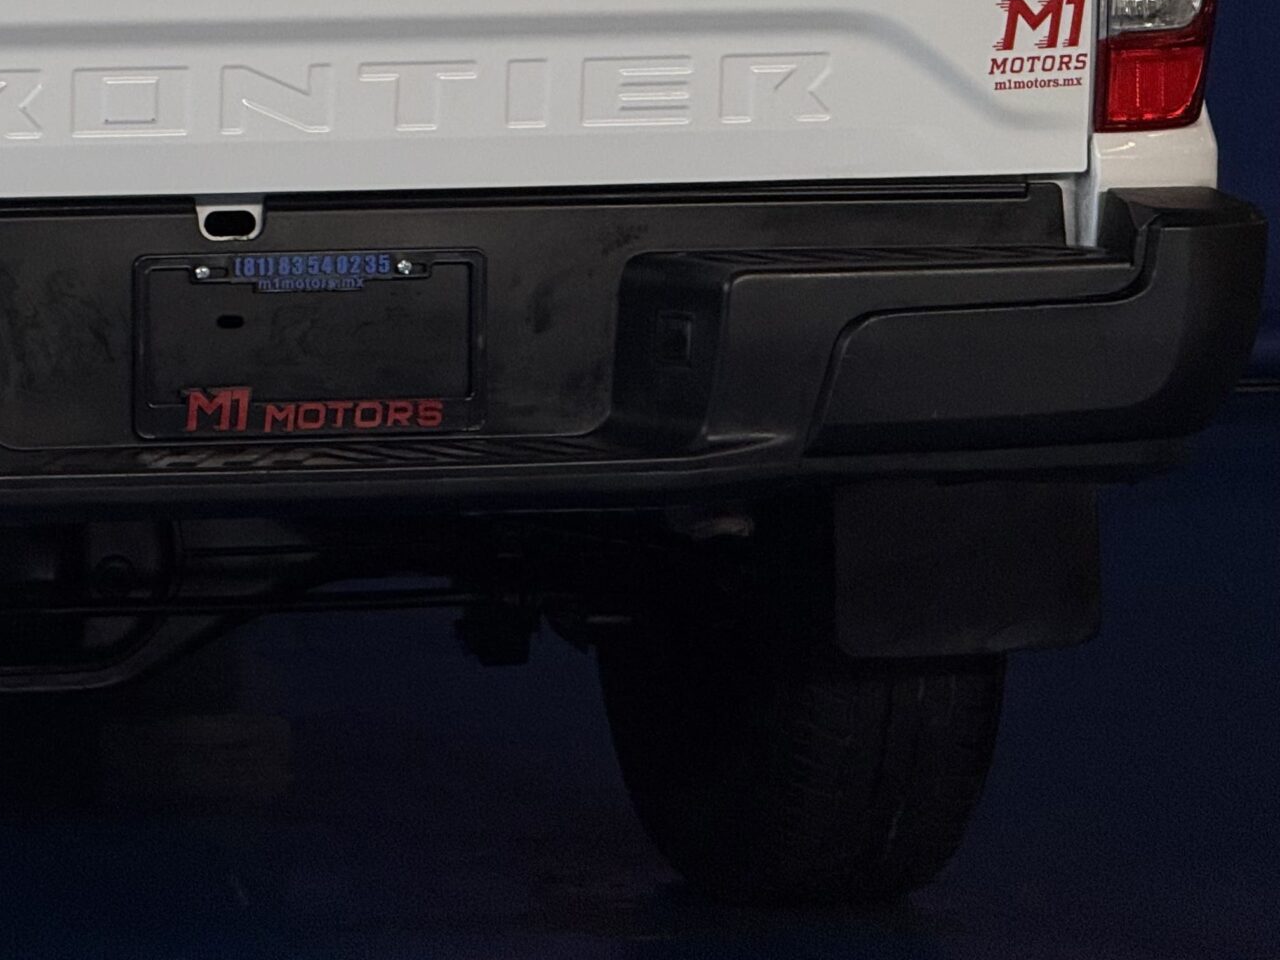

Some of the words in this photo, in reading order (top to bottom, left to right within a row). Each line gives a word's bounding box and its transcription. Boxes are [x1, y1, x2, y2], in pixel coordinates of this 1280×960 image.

[988, 52, 1088, 76] MOTORS
[184, 387, 251, 433] M1
[263, 398, 445, 433] MOTORS
